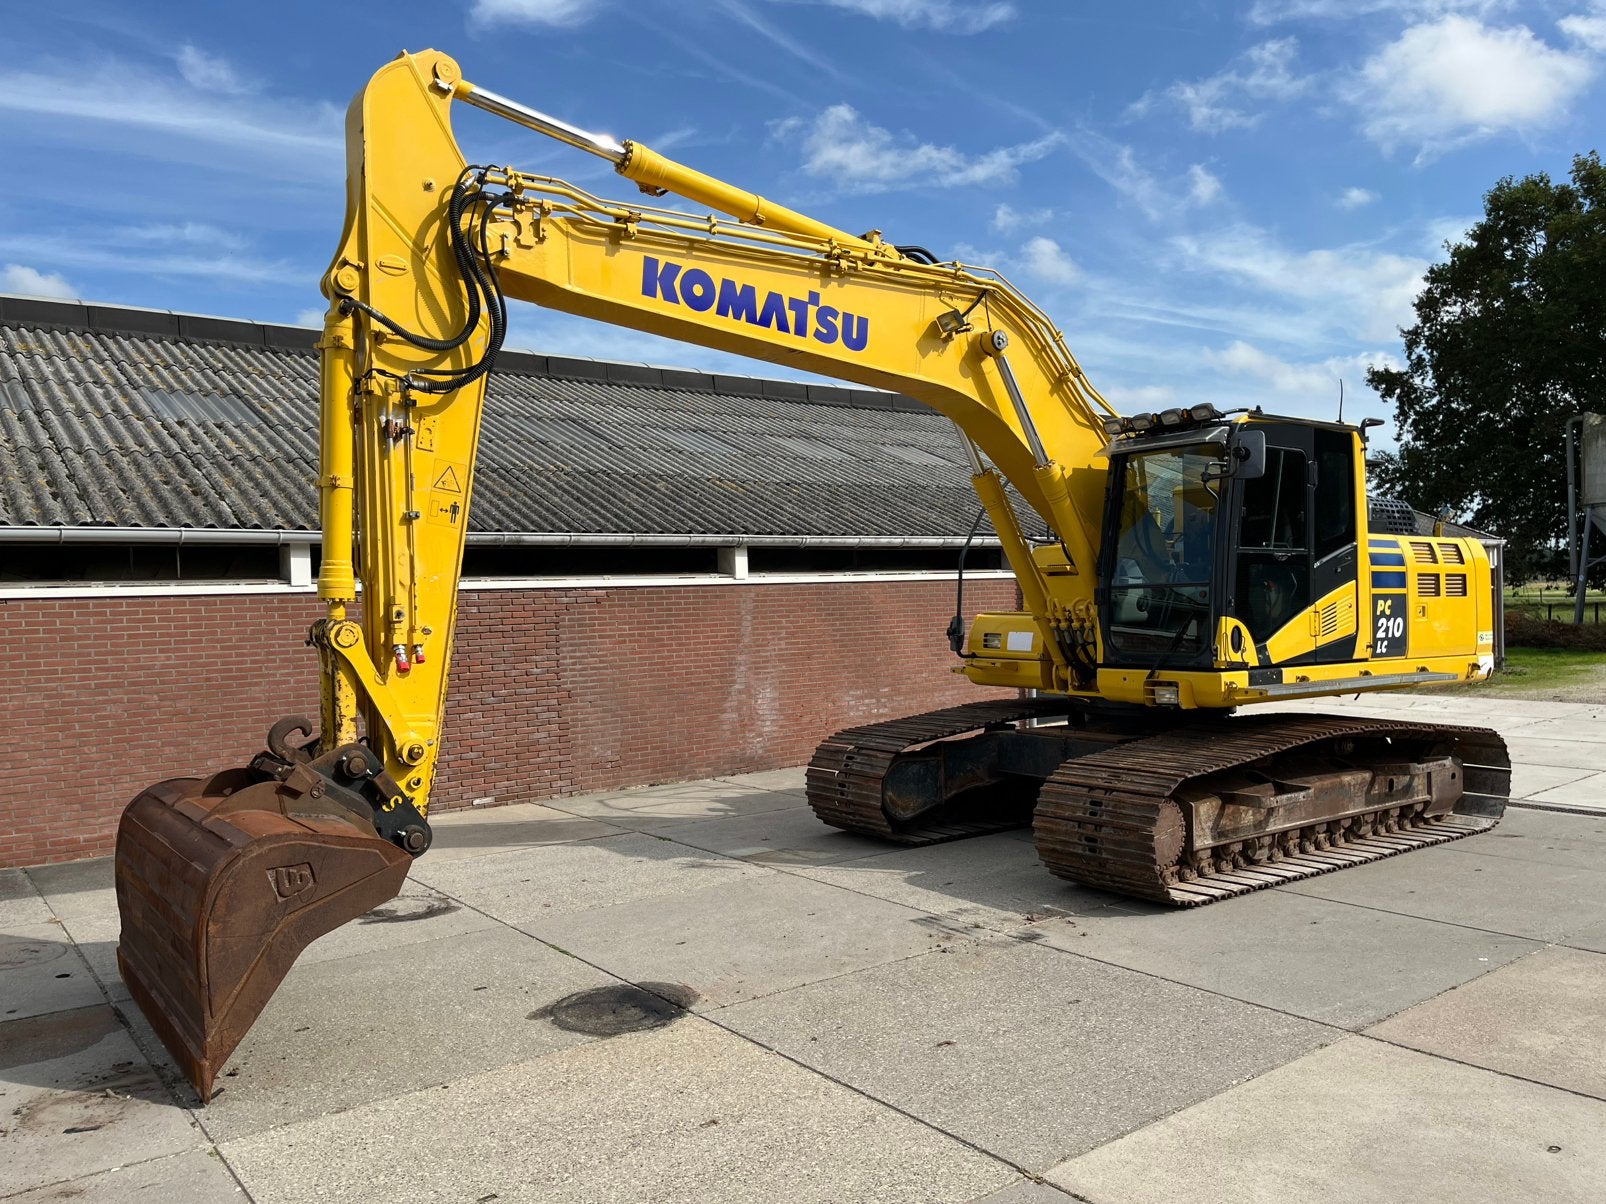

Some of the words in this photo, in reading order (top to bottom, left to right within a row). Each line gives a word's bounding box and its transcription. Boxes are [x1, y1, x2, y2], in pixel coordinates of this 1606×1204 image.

[641, 255, 869, 352] KOMATSU
[1376, 599, 1392, 615] PC
[1376, 617, 1404, 639] 210
[1375, 640, 1388, 654] LC
